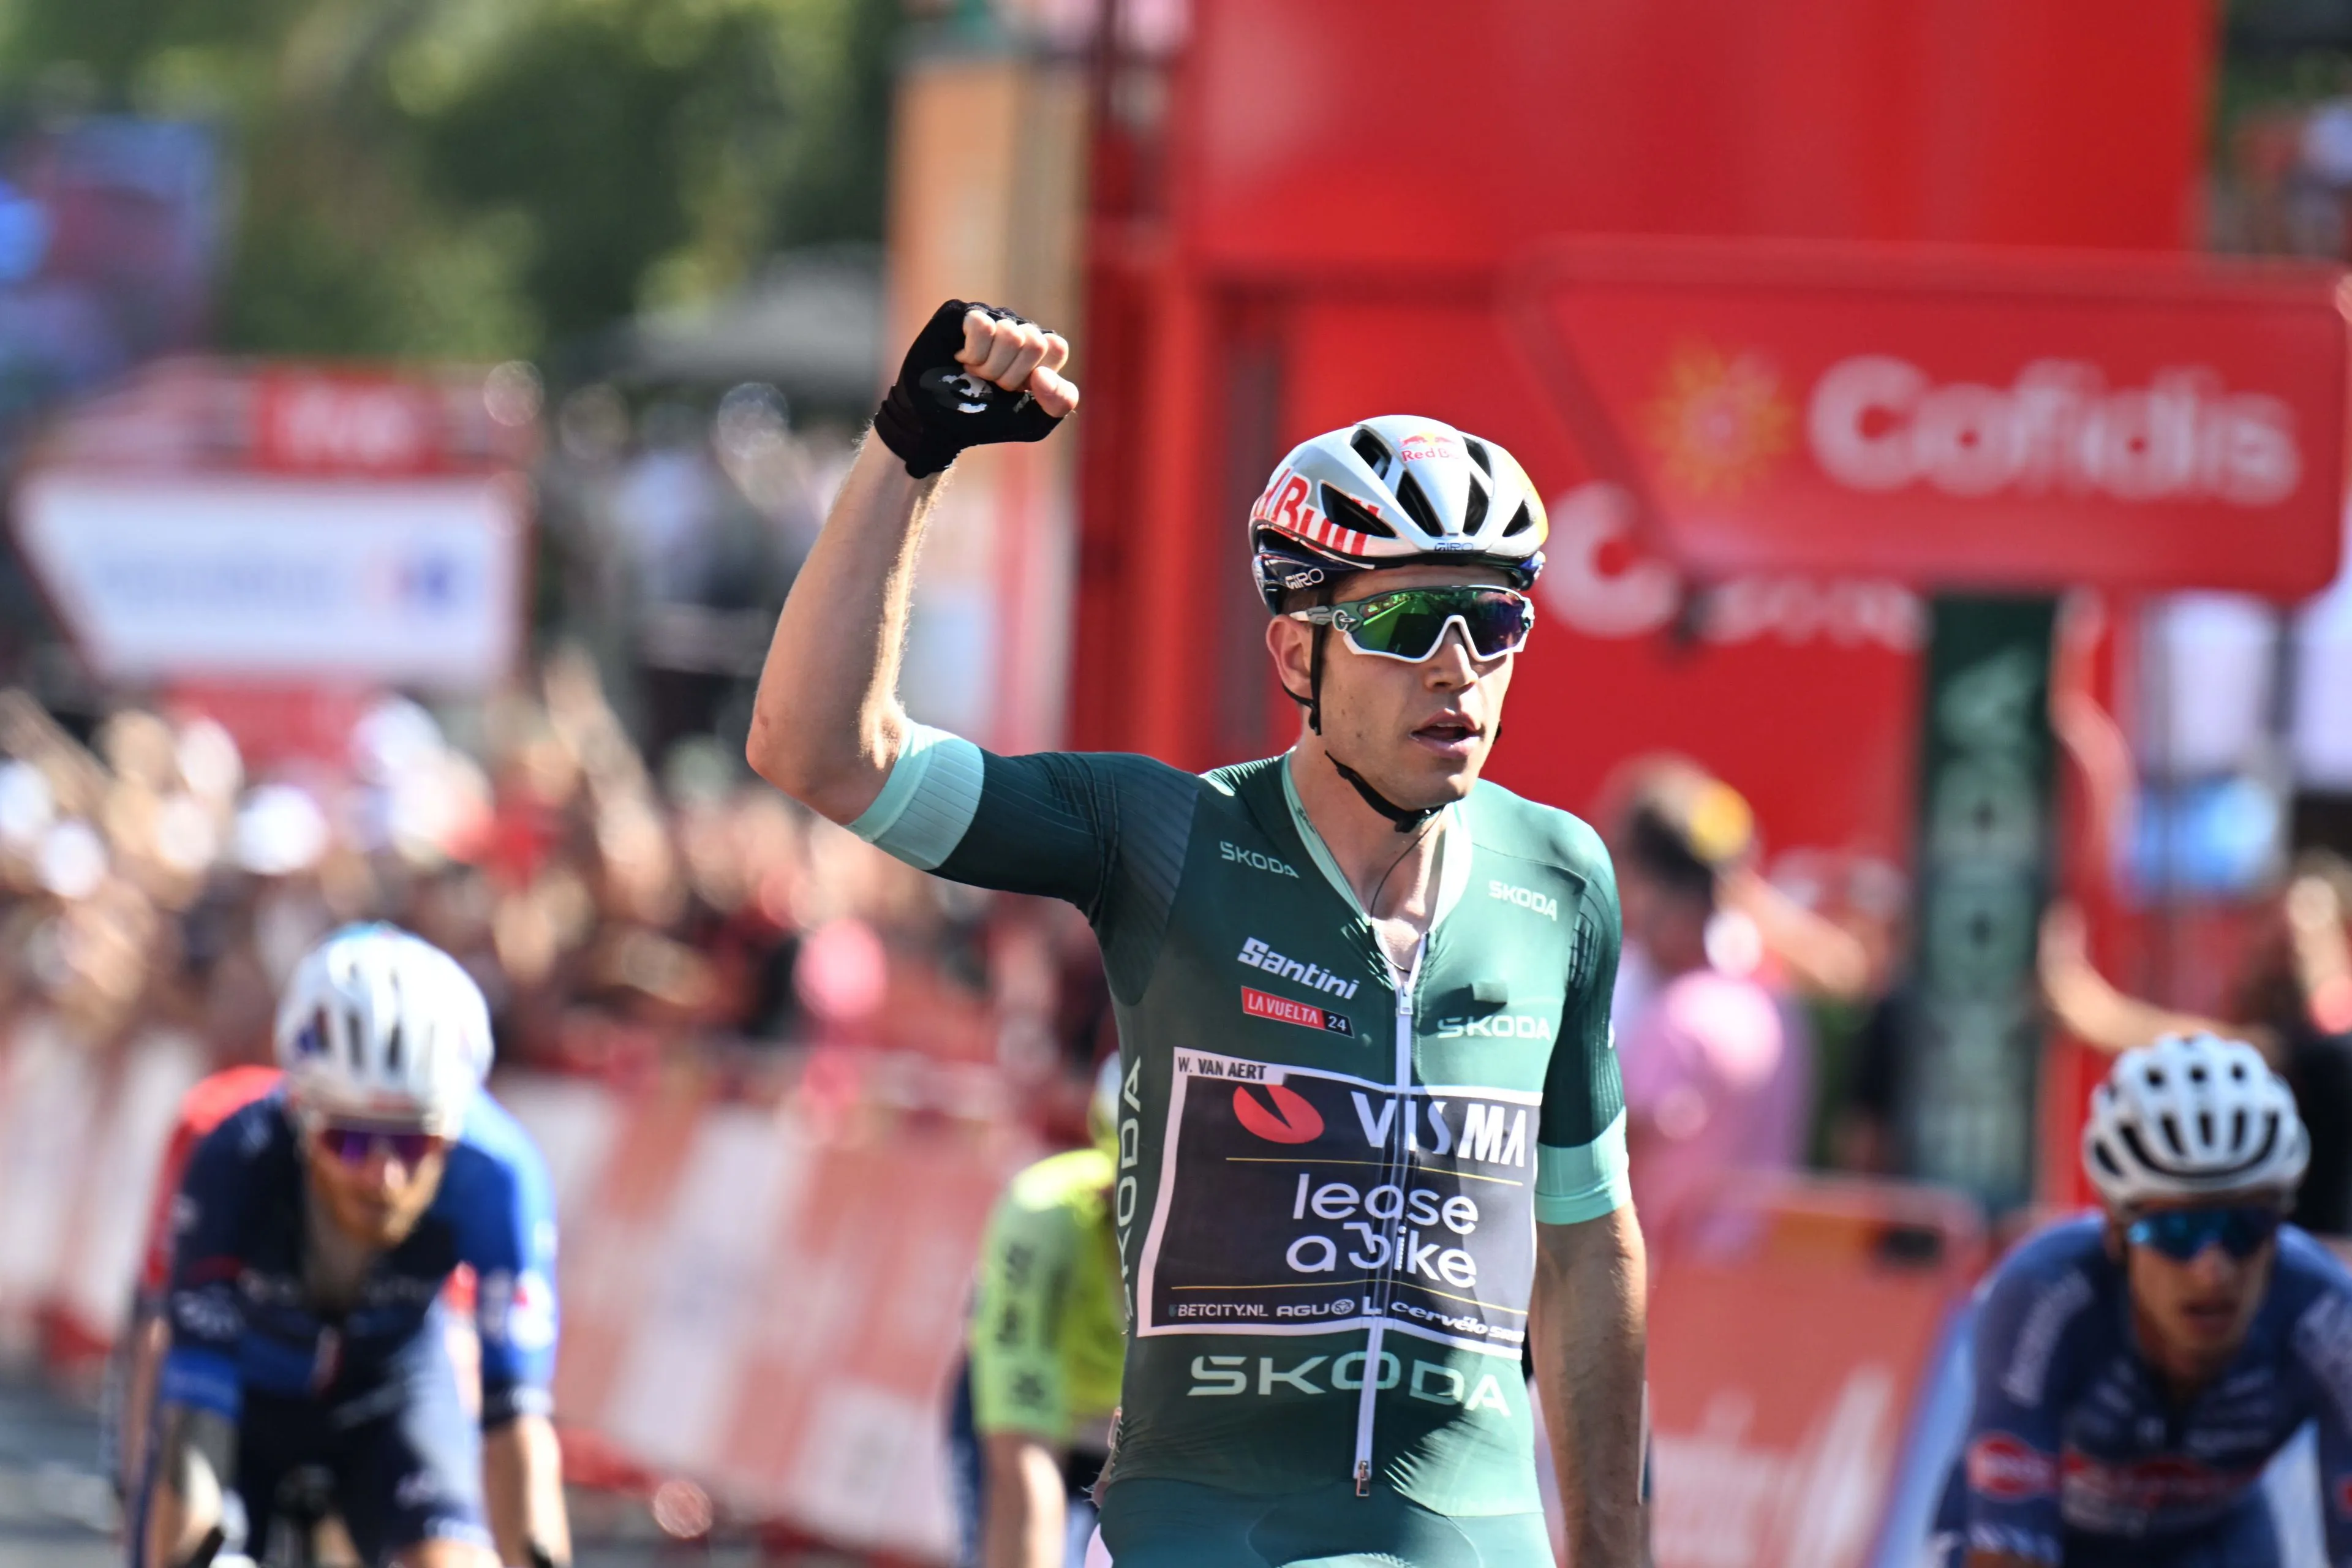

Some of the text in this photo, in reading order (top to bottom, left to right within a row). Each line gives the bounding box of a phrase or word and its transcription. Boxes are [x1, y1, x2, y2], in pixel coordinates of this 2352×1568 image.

[1810, 354, 2300, 505] Cofidis
[1401, 448, 1436, 462] Red
[1434, 542, 1474, 552] GIRO
[1285, 568, 1324, 590] GIRO
[1219, 840, 1300, 879] SKODA
[1488, 880, 1558, 922] SKODA
[1237, 937, 1360, 1000] Santini
[1248, 992, 1347, 1031] LA VUELTA 24
[1437, 1015, 1551, 1041] SKODA
[1178, 1056, 1267, 1080] W. VAN AERT
[1350, 1090, 1527, 1167] VISMA
[1292, 1173, 1479, 1235] lease
[1177, 1303, 1269, 1317] BETCITY.NL
[1276, 1304, 1330, 1317] AGU
[1186, 1351, 1512, 1417] SKODA
